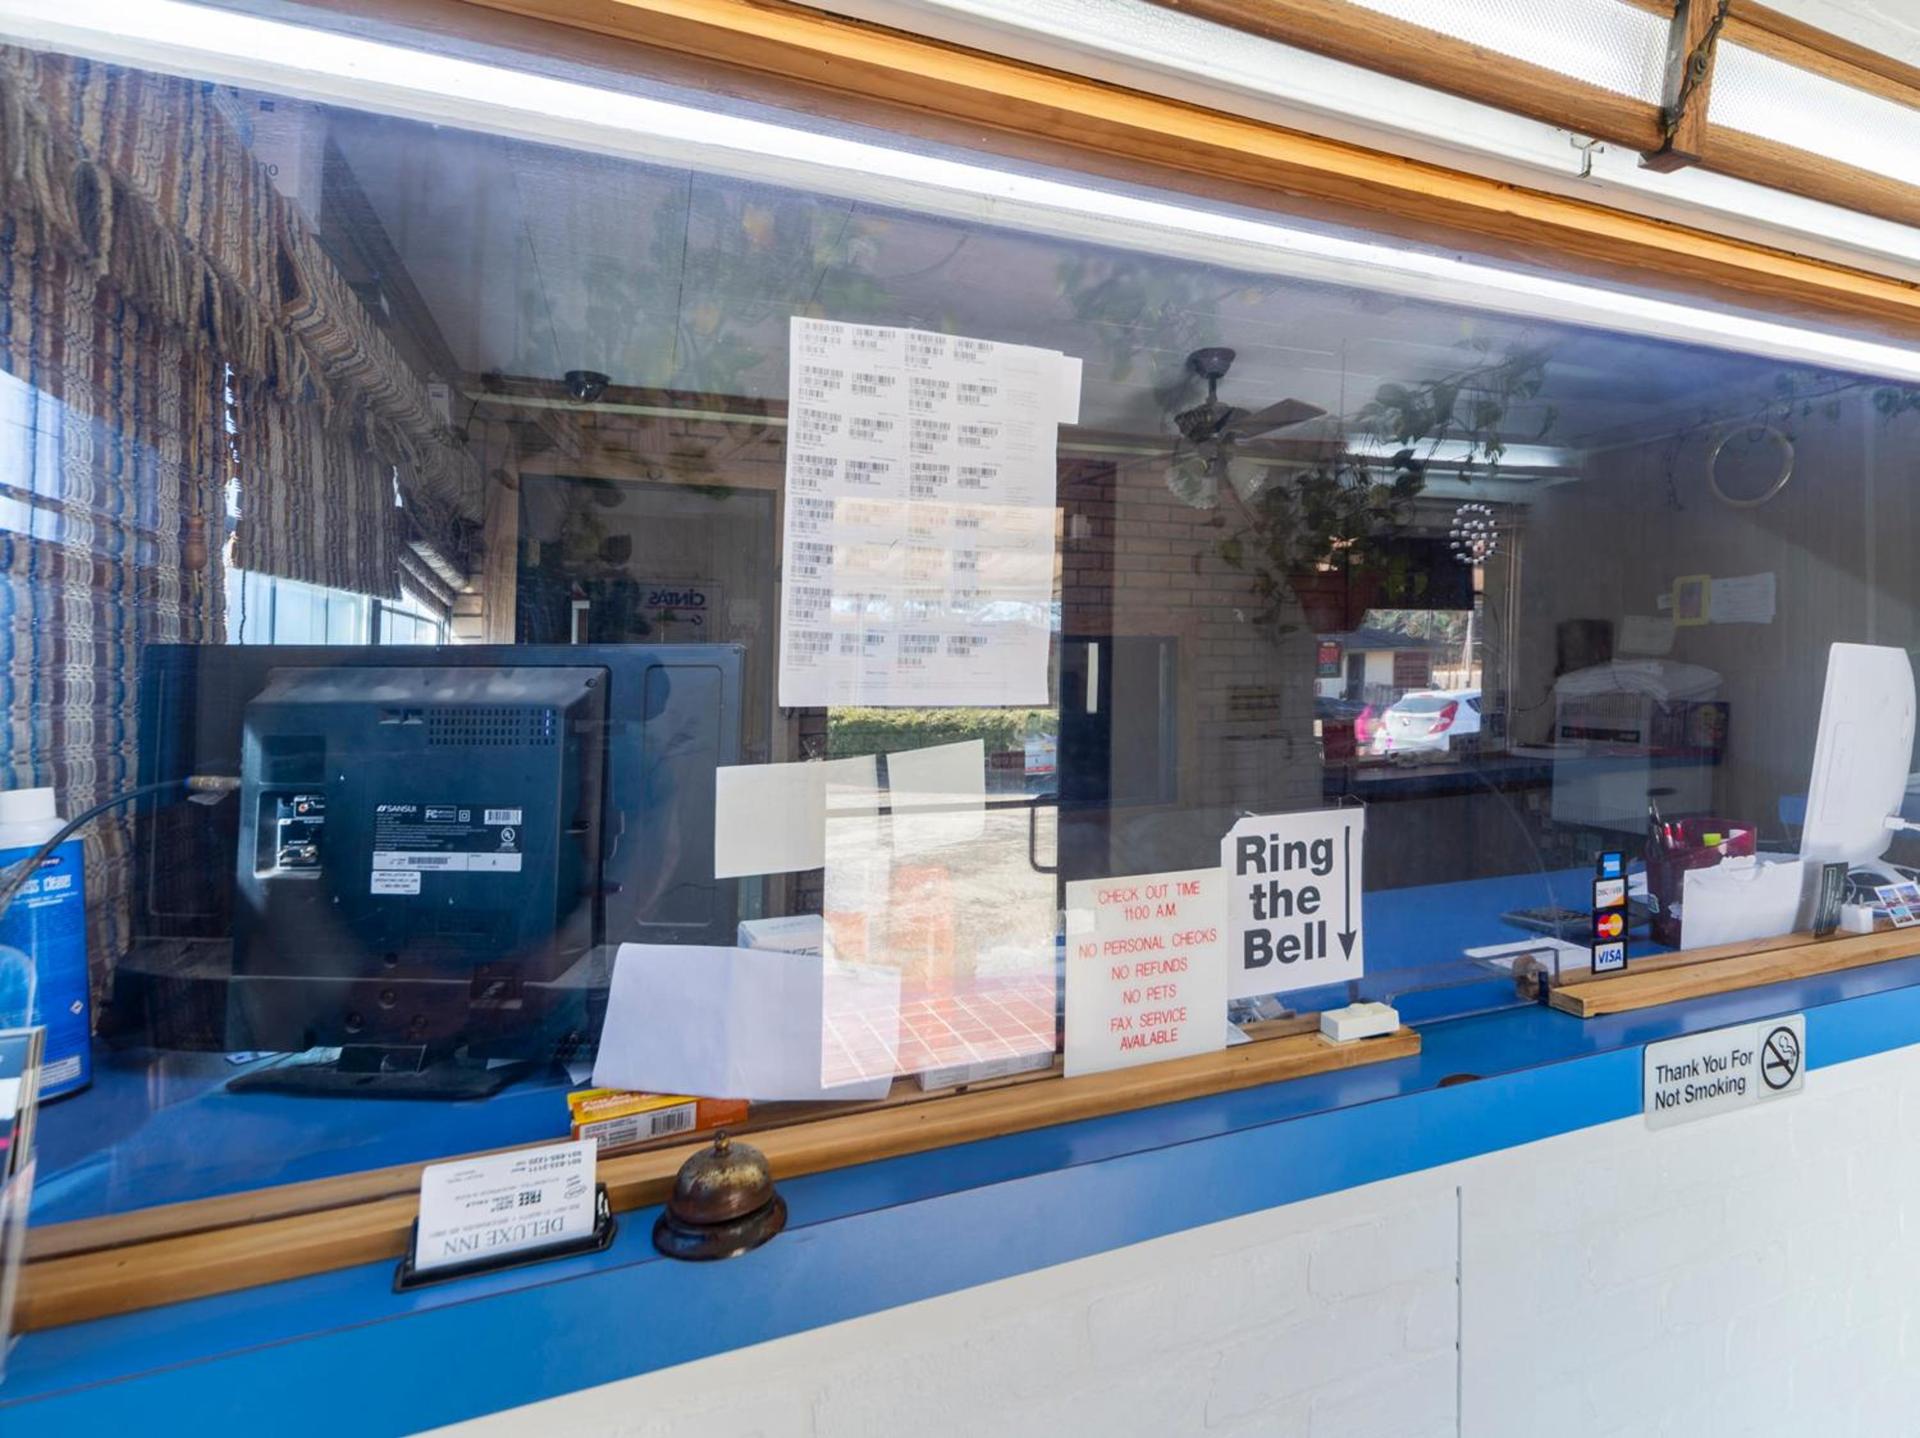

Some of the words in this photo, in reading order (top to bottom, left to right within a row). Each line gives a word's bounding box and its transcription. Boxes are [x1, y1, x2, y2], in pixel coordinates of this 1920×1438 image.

[1236, 833, 1333, 876] Ring
[1098, 888, 1139, 905] CHECK
[1145, 884, 1169, 900] OUT
[1176, 880, 1201, 897] TIME
[1249, 880, 1321, 921] the
[1078, 943, 1098, 960] NO
[1104, 935, 1165, 956] PERSONAL
[1172, 928, 1217, 948] CHECKS
[1244, 920, 1327, 970] Bell
[1598, 948, 1622, 964] VISA
[1111, 965, 1130, 981] NO
[1136, 956, 1188, 978] REFUNDS
[1123, 989, 1141, 1005] NO
[1147, 984, 1177, 1001] PETS
[1110, 1016, 1133, 1033] FAX
[1139, 1007, 1187, 1028] SERVICE
[1119, 1028, 1178, 1051] AVAILABLE
[1656, 1060, 1700, 1084] Thank
[1702, 1055, 1727, 1074] You
[1731, 1049, 1754, 1068] For
[1655, 1090, 1681, 1111] Not
[1684, 1076, 1746, 1104] Smoking
[518, 1189, 542, 1208] FREE
[487, 1215, 565, 1247] DELUXE
[443, 1233, 480, 1256] INN
